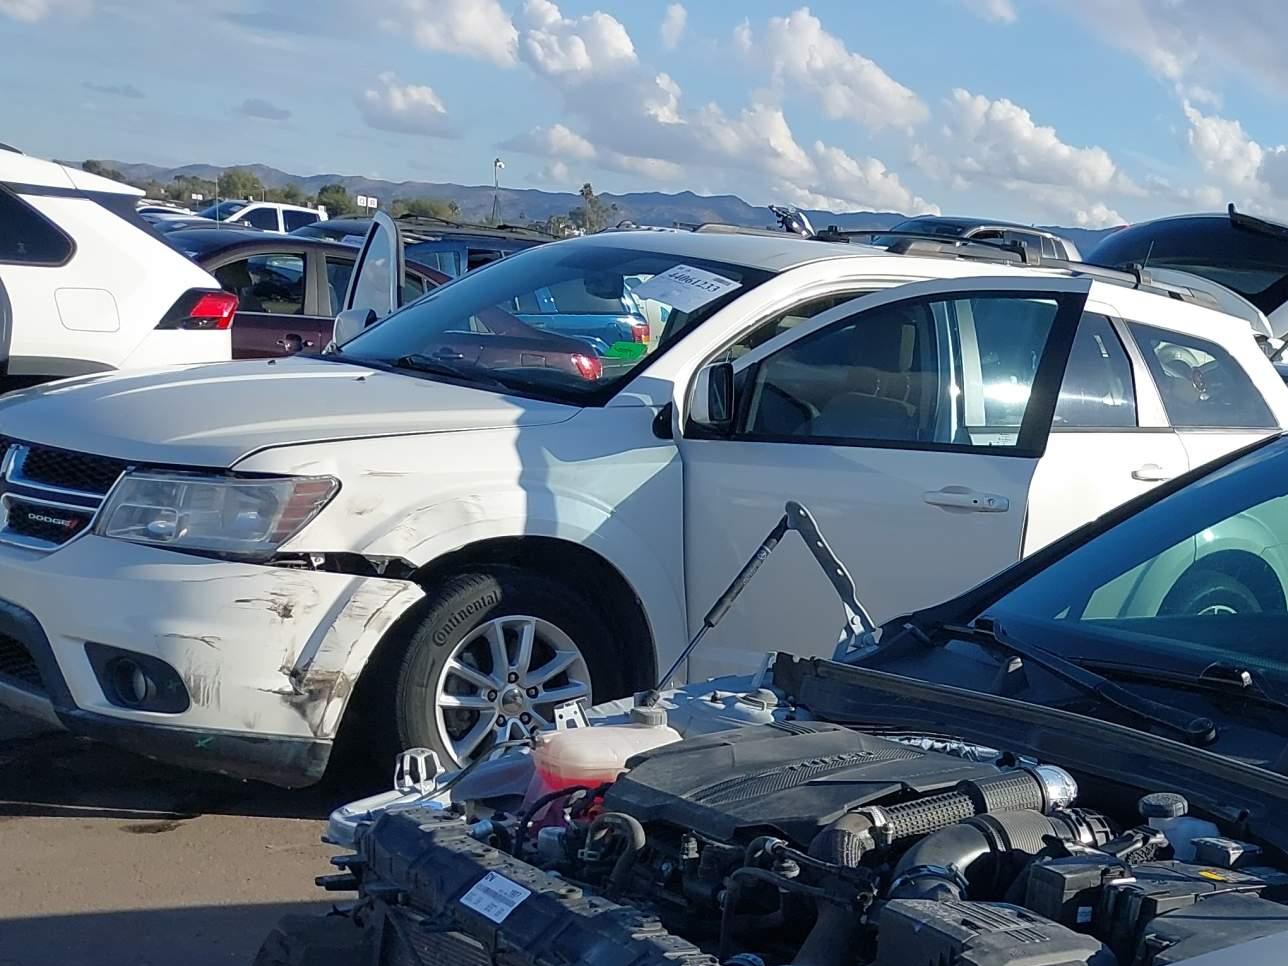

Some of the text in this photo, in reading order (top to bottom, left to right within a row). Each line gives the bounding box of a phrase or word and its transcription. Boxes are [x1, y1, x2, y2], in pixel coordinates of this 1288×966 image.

[668, 272, 721, 293] 44061233
[28, 513, 70, 526] DODGE
[432, 590, 499, 647] Continental
